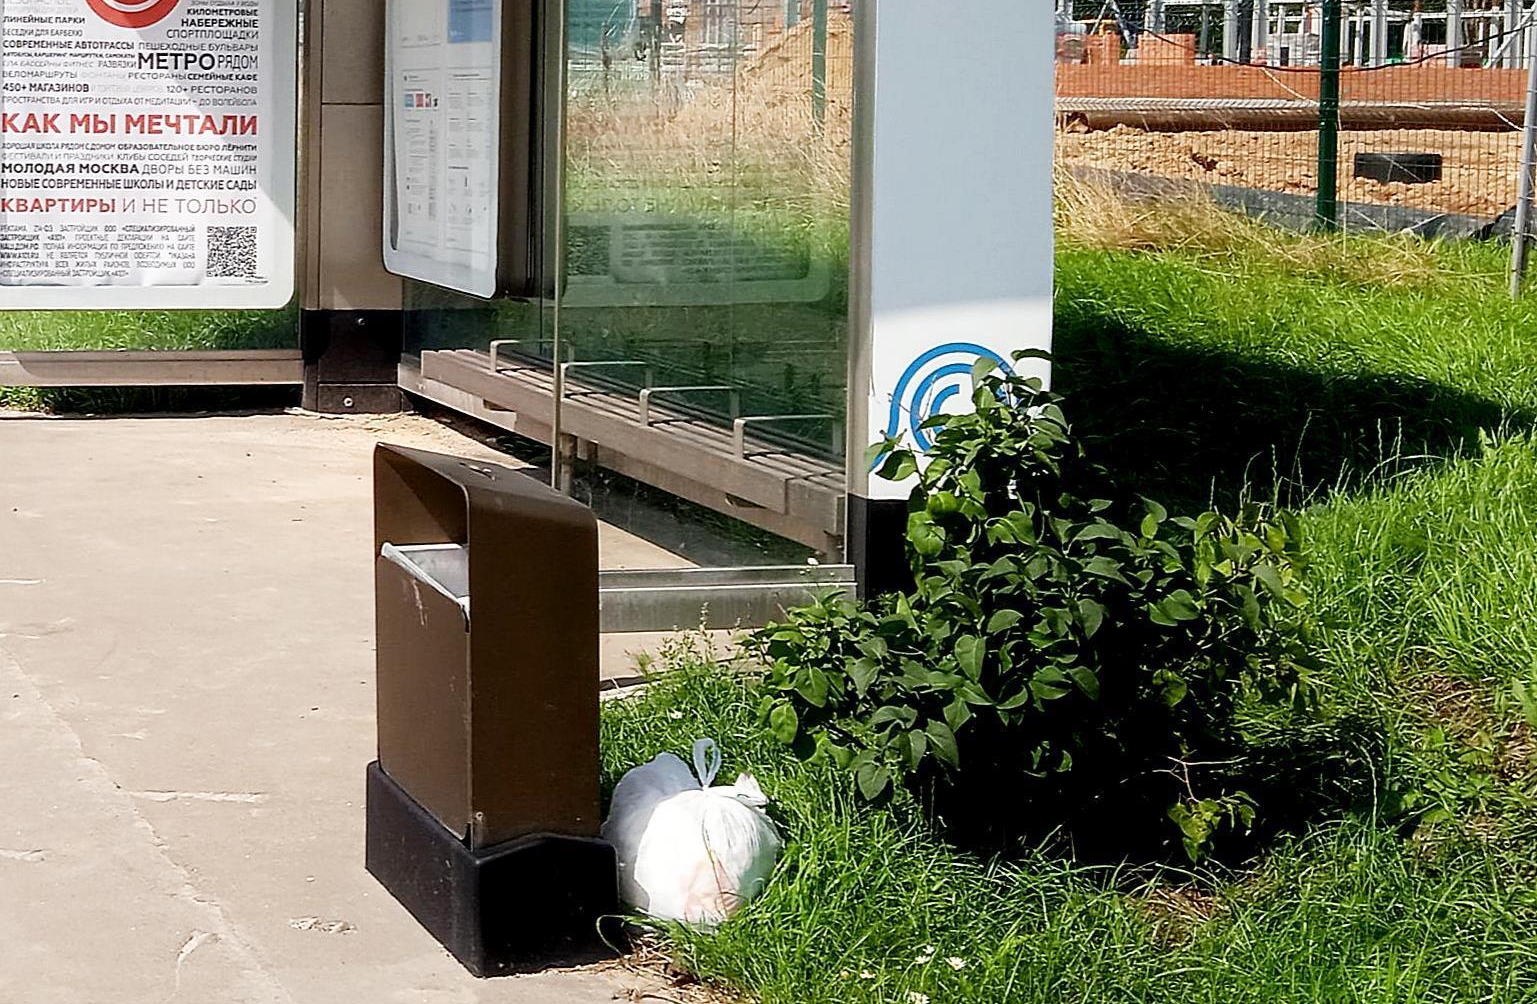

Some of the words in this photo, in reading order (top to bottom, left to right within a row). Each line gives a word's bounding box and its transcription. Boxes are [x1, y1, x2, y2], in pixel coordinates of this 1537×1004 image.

[187, 8, 258, 16] КИЛОМЕТРОВЫЕ
[3, 14, 54, 24] ЛИНЕЙНЫЕ
[55, 16, 86, 24] ПАРКИ
[181, 18, 259, 28] НАБЕРЕЖНЫЕ
[166, 29, 259, 40] СПОРТПЛОЩАДКИ
[2, 40, 72, 48] СОВРЕМЕННЫЕ
[74, 41, 134, 50] АВТОТРАССЫ
[138, 42, 207, 51] ПЕШЕХОДНЫЕ
[208, 43, 258, 52] БУЛЬВАРЫ
[138, 52, 216, 70] МЕТРО
[218, 54, 258, 70] РЯДОМ
[2, 70, 78, 78] ВЕЛОМАРШРУТЫ
[128, 72, 186, 80] РЕСТОРАНЫ
[187, 72, 234, 80] СЕМЕЙНЫЕ
[2, 83, 27, 92] 450+
[29, 83, 90, 92] МАГАЗИНОВ
[166, 86, 188, 94] 120+
[190, 86, 258, 94] РЕСТОРАНОВ
[2, 96, 60, 104] ПРОСТРАНСТВА
[199, 98, 211, 106] ДО
[212, 98, 257, 106] ВОЛЕЙБОЛА
[2, 113, 62, 133] КАК
[70, 114, 116, 134] МЫ
[125, 114, 258, 135] МЕЧТАЛИ
[148, 152, 188, 162] СОСЕДЕЙ
[1, 162, 76, 174] МОЛОДАЯ
[79, 163, 140, 174] МОСКВА
[142, 164, 184, 176] ДВОРЫ
[188, 164, 210, 174] БЕЗ
[213, 164, 257, 174] МАШИН
[1, 178, 40, 188] НОВЫЕ
[42, 178, 122, 189] СОВРЕМЕННЫЕ
[123, 179, 164, 190] ШКОЛЫ
[166, 180, 174, 189] И
[176, 180, 224, 190] ДЕТСКИЕ
[226, 180, 257, 191] САДЫ
[1, 198, 116, 212] КВАРТИРЫ
[123, 198, 135, 213] И
[143, 198, 168, 213] НЕ
